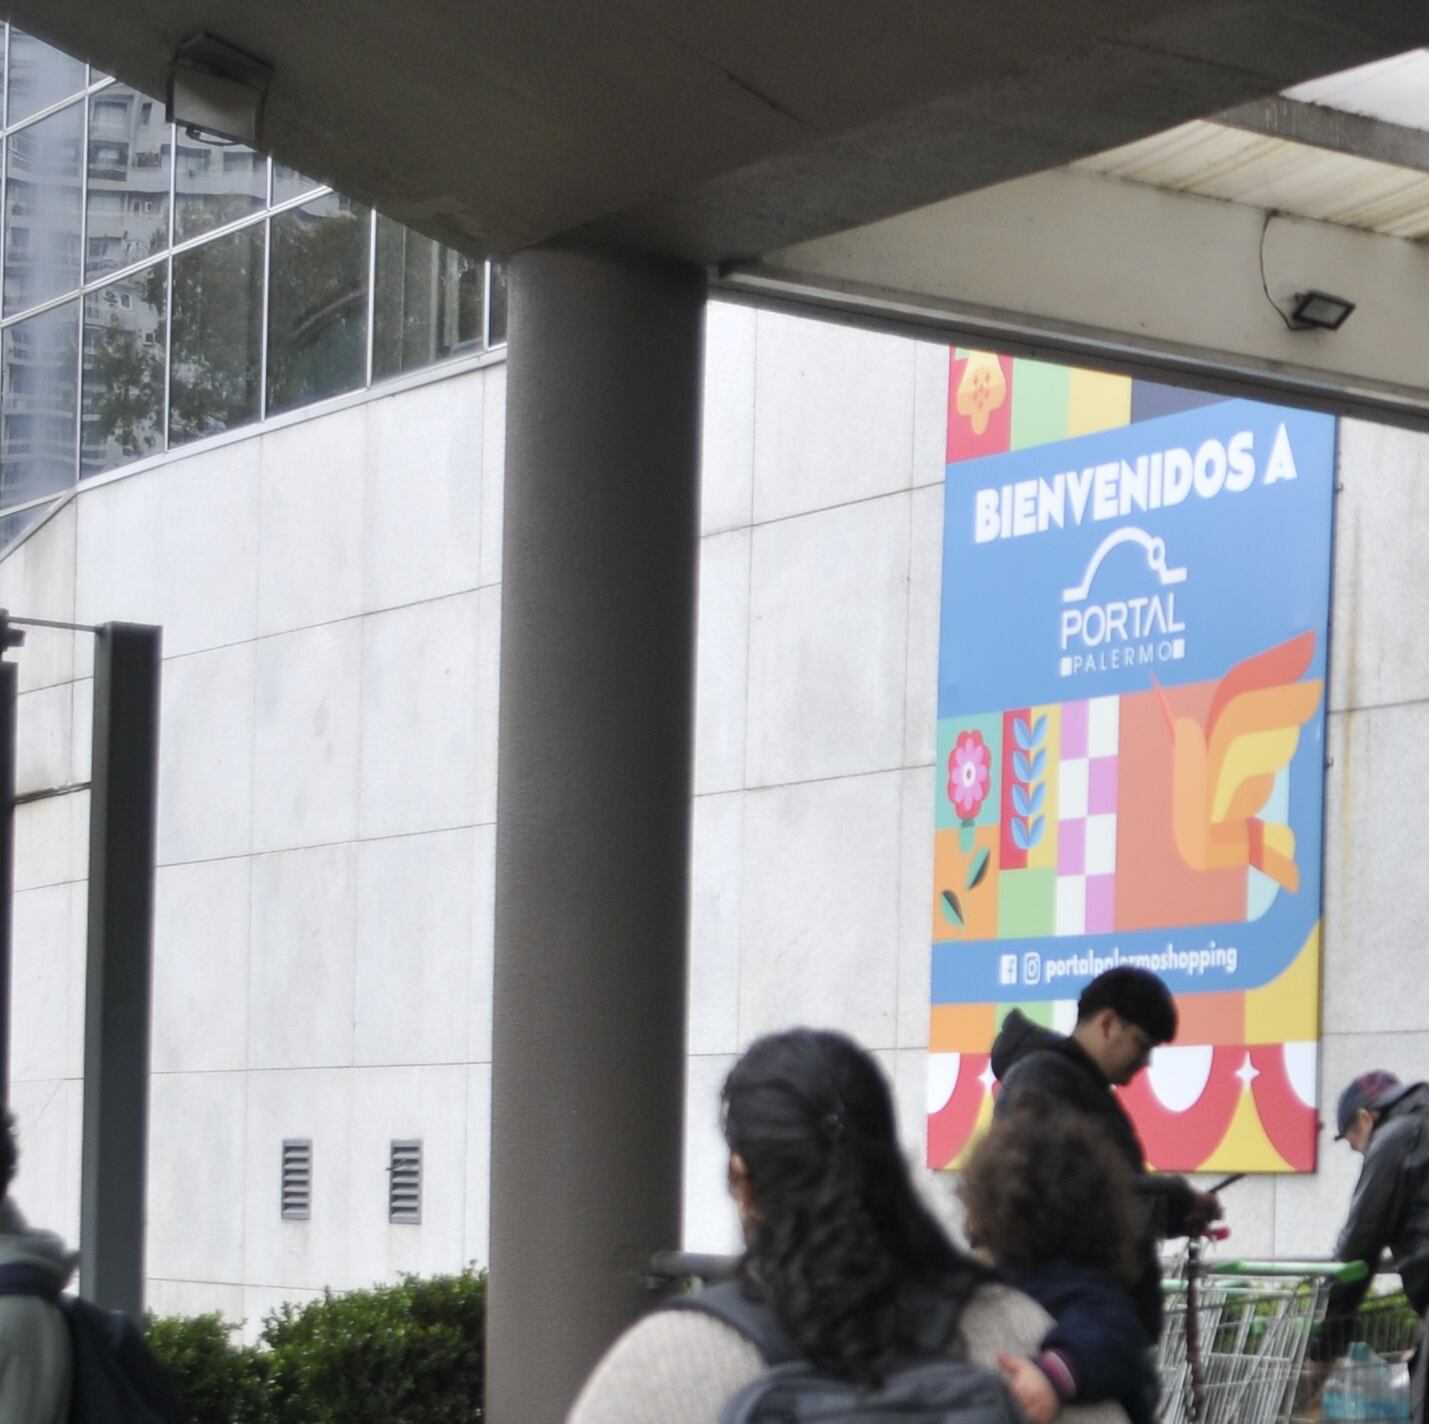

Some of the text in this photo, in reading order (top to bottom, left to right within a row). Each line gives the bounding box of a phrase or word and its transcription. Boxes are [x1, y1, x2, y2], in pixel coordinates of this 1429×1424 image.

[974, 420, 1298, 544] BIENVENIDOS A
[1061, 592, 1185, 649] PORTAL
[1073, 643, 1172, 674] PALERMO
